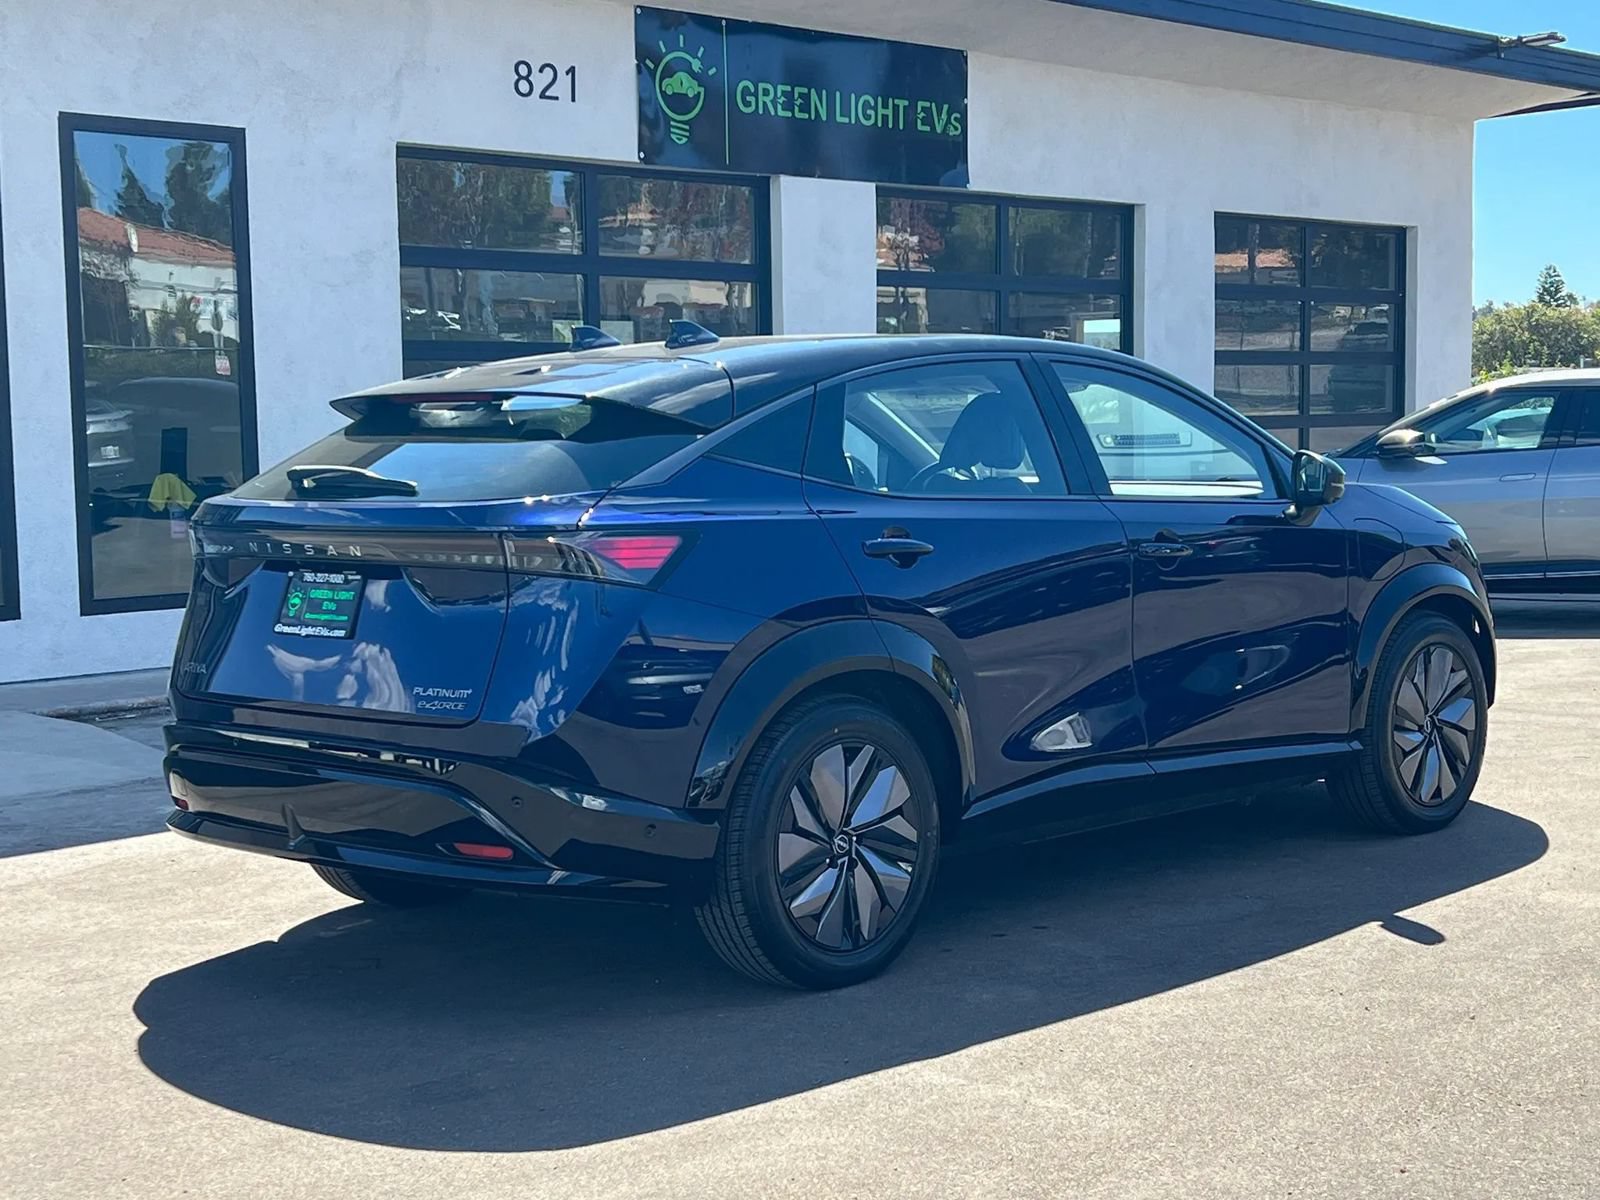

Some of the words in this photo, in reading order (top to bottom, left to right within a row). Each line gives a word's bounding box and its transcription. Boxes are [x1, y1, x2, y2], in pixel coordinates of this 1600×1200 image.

[513, 60, 576, 103] 821
[736, 80, 827, 121] GREEN
[835, 90, 909, 130] LIGHT
[917, 101, 962, 136] EVs
[249, 542, 361, 557] NISSAN
[309, 589, 333, 599] GREEN
[334, 591, 355, 600] LIGHT
